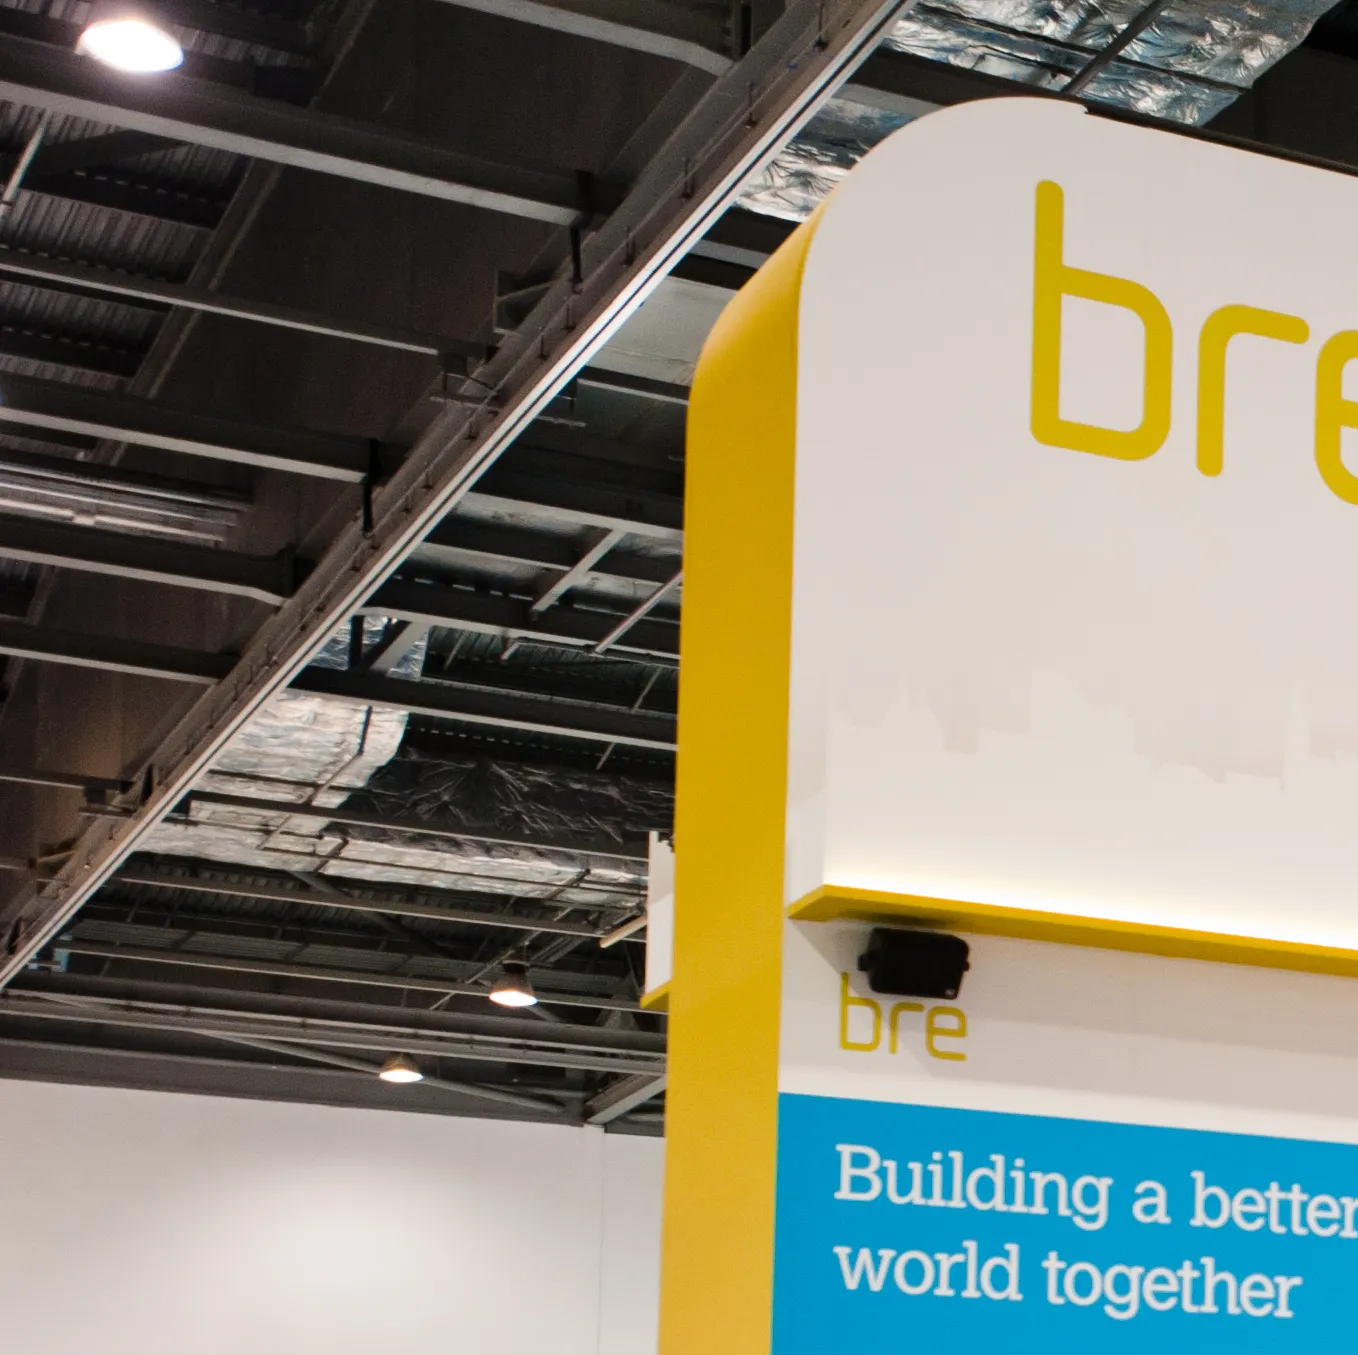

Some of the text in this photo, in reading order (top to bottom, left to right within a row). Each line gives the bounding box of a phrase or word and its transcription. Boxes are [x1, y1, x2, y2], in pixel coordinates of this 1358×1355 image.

[840, 971, 968, 1061] bre
[833, 1142, 1113, 1231] Building
[1132, 1179, 1171, 1224] a
[833, 1240, 1302, 1320] world together
